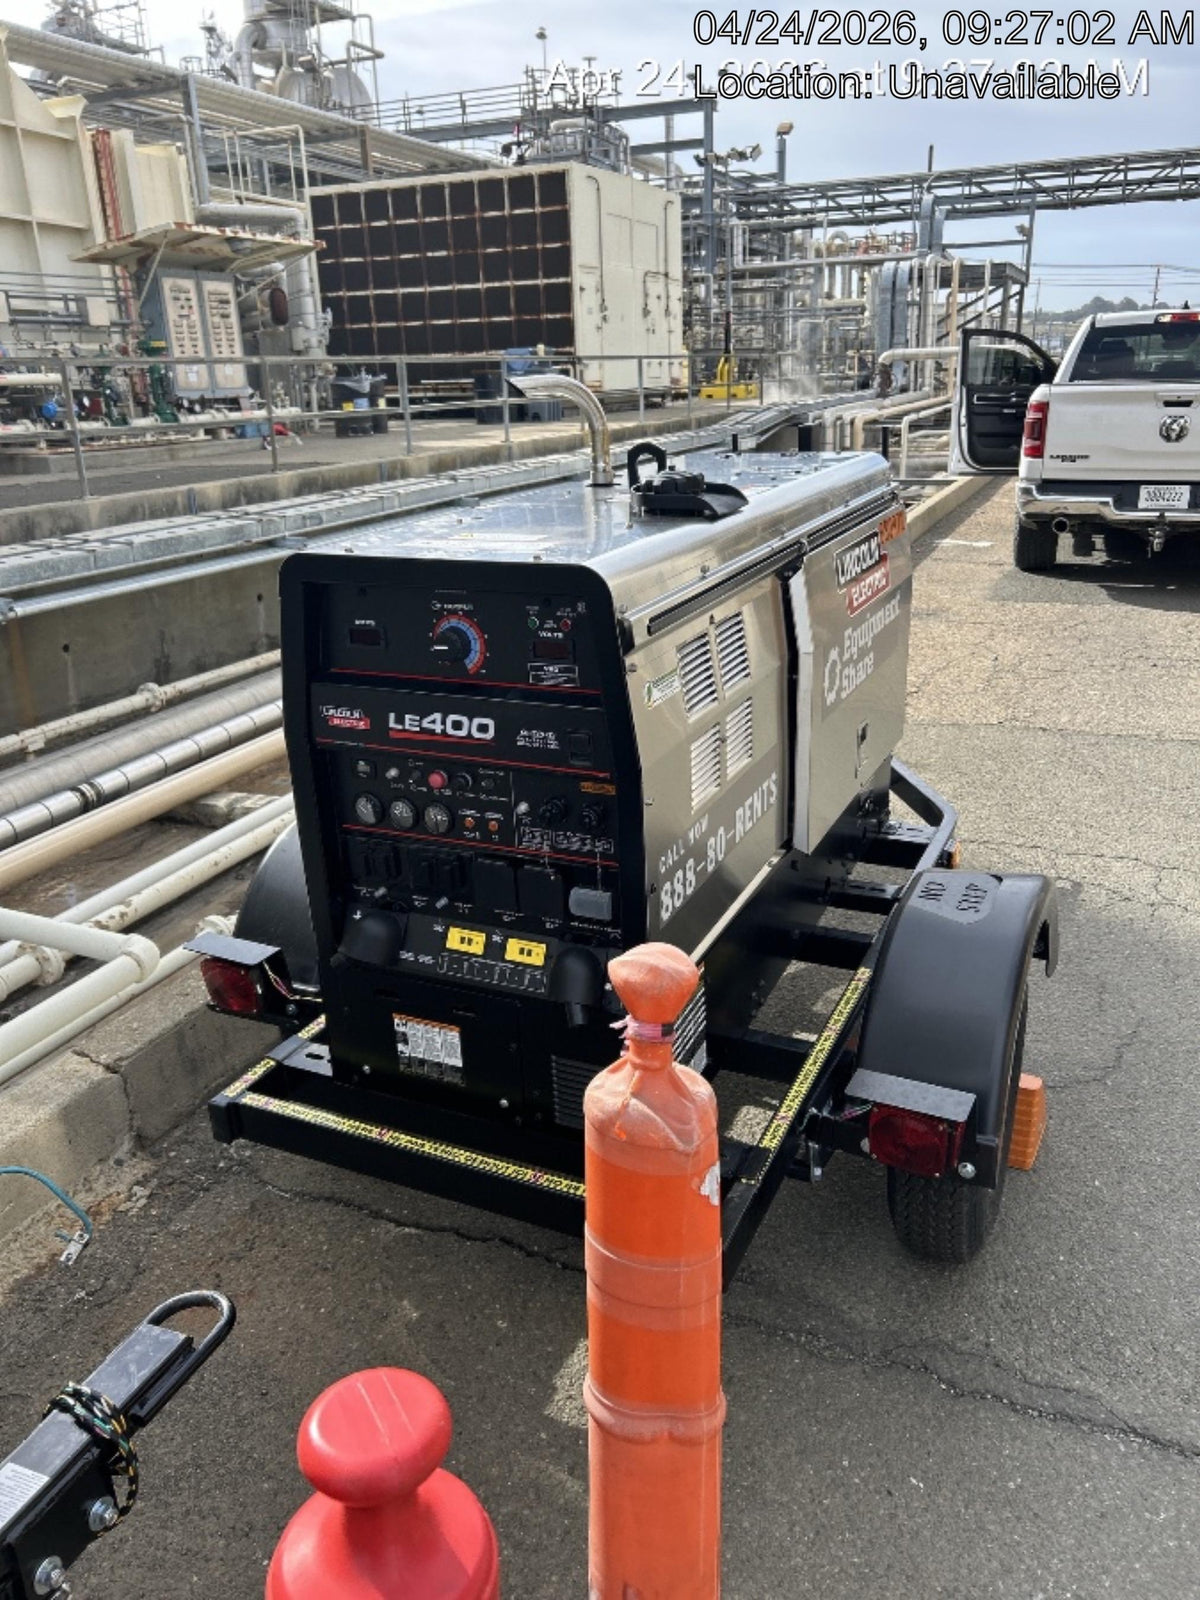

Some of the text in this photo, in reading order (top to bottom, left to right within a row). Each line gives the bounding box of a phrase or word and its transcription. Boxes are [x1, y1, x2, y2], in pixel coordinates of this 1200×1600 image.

[836, 536, 880, 585] LINCOLN
[842, 593, 900, 660] Equipment
[840, 651, 875, 700] Share
[388, 712, 496, 740] LE400
[658, 813, 710, 874] CALL NOW
[659, 769, 779, 922] 888-80-RENTS
